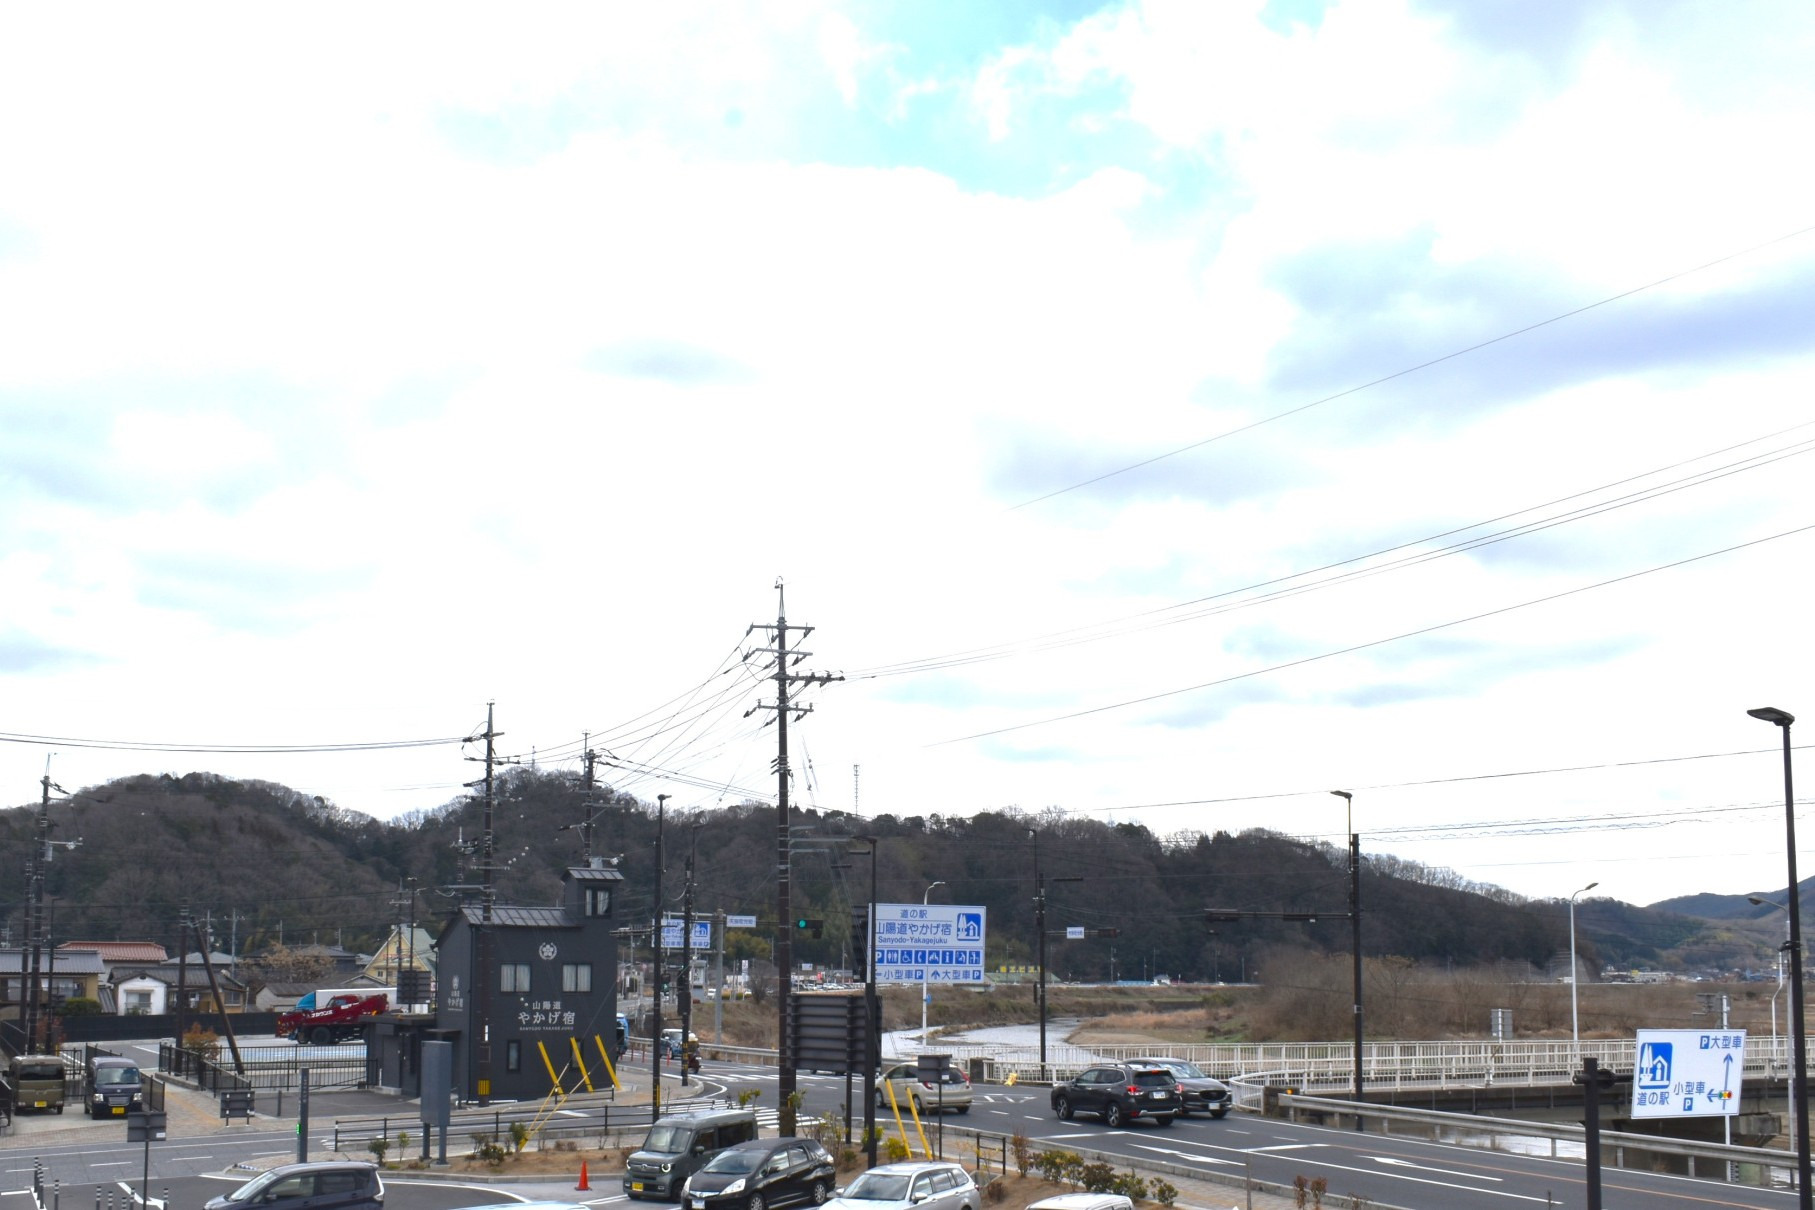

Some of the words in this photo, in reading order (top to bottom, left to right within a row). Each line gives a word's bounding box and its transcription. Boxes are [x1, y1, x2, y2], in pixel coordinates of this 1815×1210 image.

[900, 909, 928, 919] 道の駅
[876, 922, 952, 936] 山陽道やかげ宿
[878, 936, 948, 945] Sanyodo-Yakagejuku
[884, 970, 914, 979] 小型車
[942, 970, 970, 980] 大型車
[532, 1001, 561, 1010] 山陽道
[518, 1011, 576, 1025] やかげ宿
[1710, 1035, 1742, 1049] 大型車
[1673, 1081, 1705, 1095] 小型車
[1637, 1091, 1670, 1106] 道の駅
